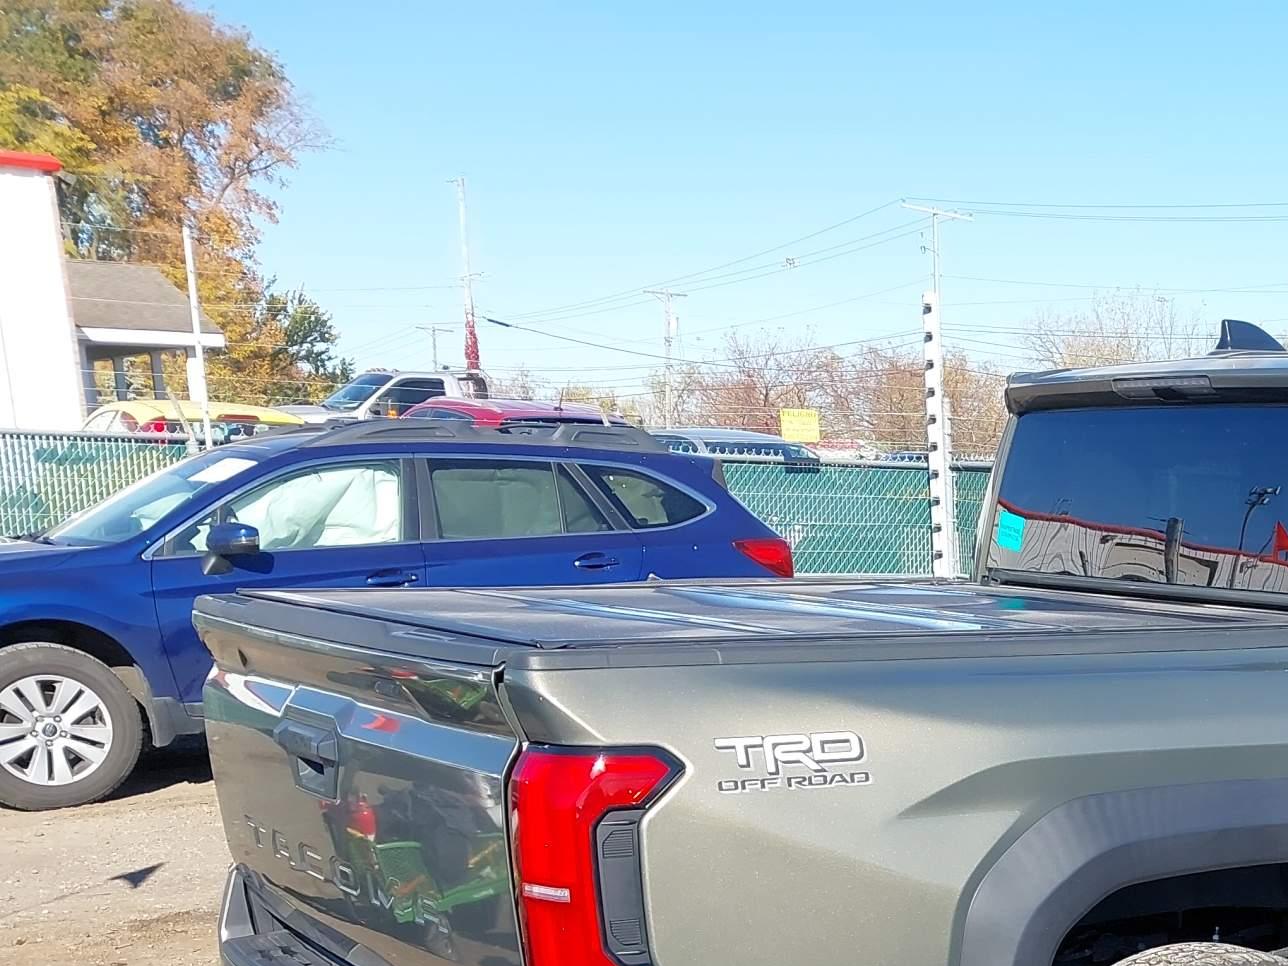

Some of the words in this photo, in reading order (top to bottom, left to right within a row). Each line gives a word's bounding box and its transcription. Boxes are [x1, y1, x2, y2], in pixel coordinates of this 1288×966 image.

[714, 731, 866, 776] TRD
[718, 777, 779, 793] OFF
[786, 772, 871, 788] ROAD
[244, 813, 449, 935] TACOMA
